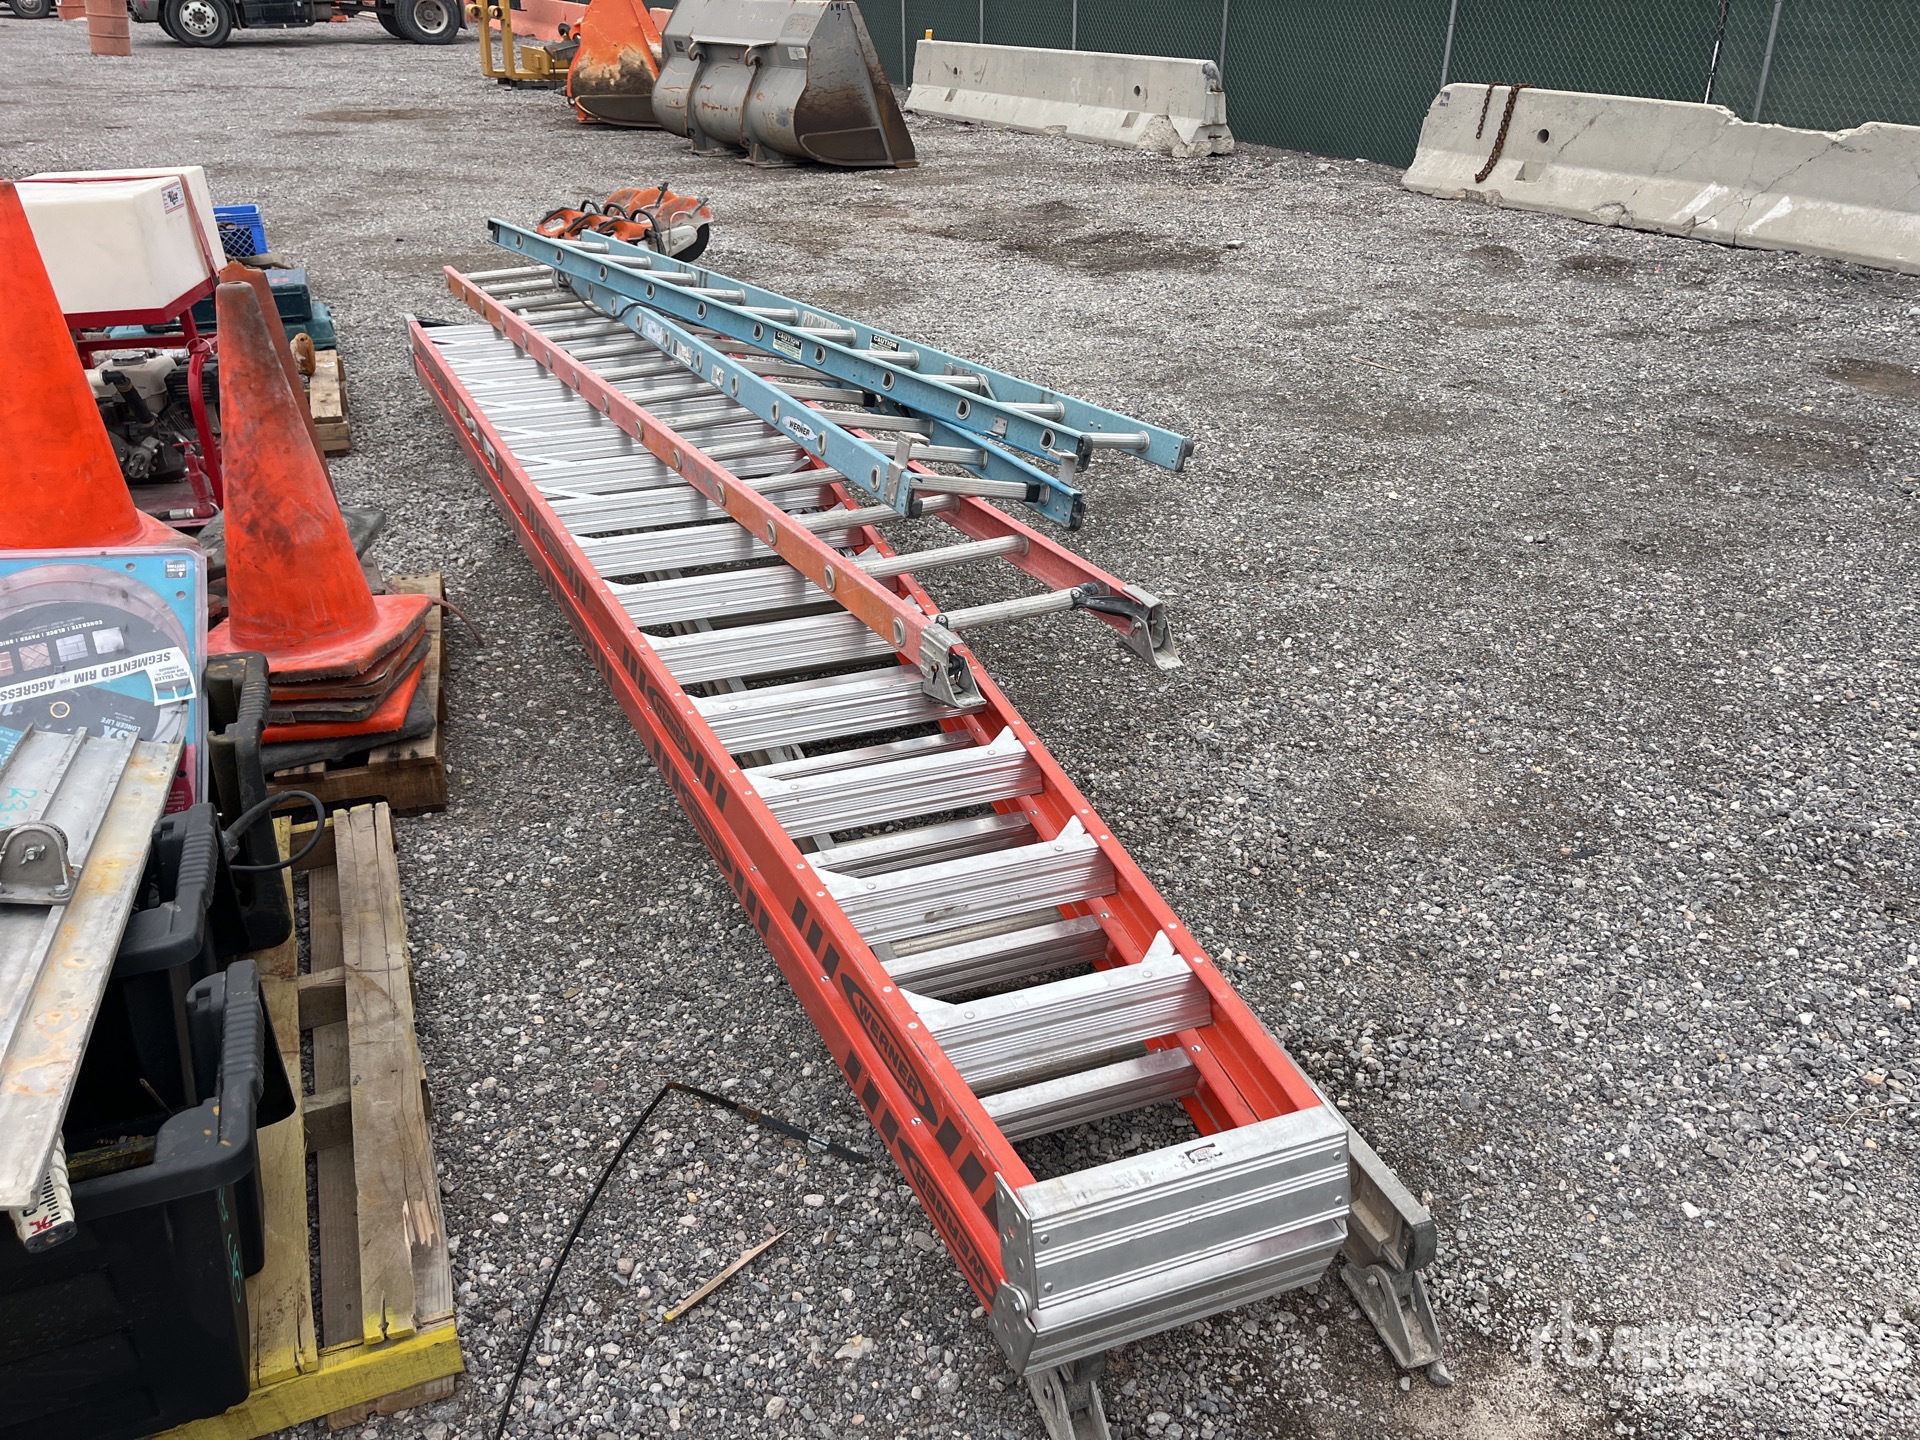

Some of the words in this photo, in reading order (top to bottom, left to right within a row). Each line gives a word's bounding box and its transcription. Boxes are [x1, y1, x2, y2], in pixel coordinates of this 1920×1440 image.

[776, 331, 800, 345] CAUTION
[873, 335, 898, 348] CAUTION
[789, 420, 810, 436] WERNER
[46, 627, 66, 636] BLOCK
[71, 620, 103, 630] CONCRETE
[19, 633, 40, 642] PAVER
[101, 652, 171, 679] SEGMENTED
[74, 669, 97, 684] RIM
[153, 674, 175, 682] TALLER
[0, 680, 56, 701] AGGRESS
[100, 716, 115, 726] LIFE
[115, 720, 141, 732] LONGER
[858, 1002, 920, 1098] WERNER
[914, 1166, 985, 1285] WERNER
